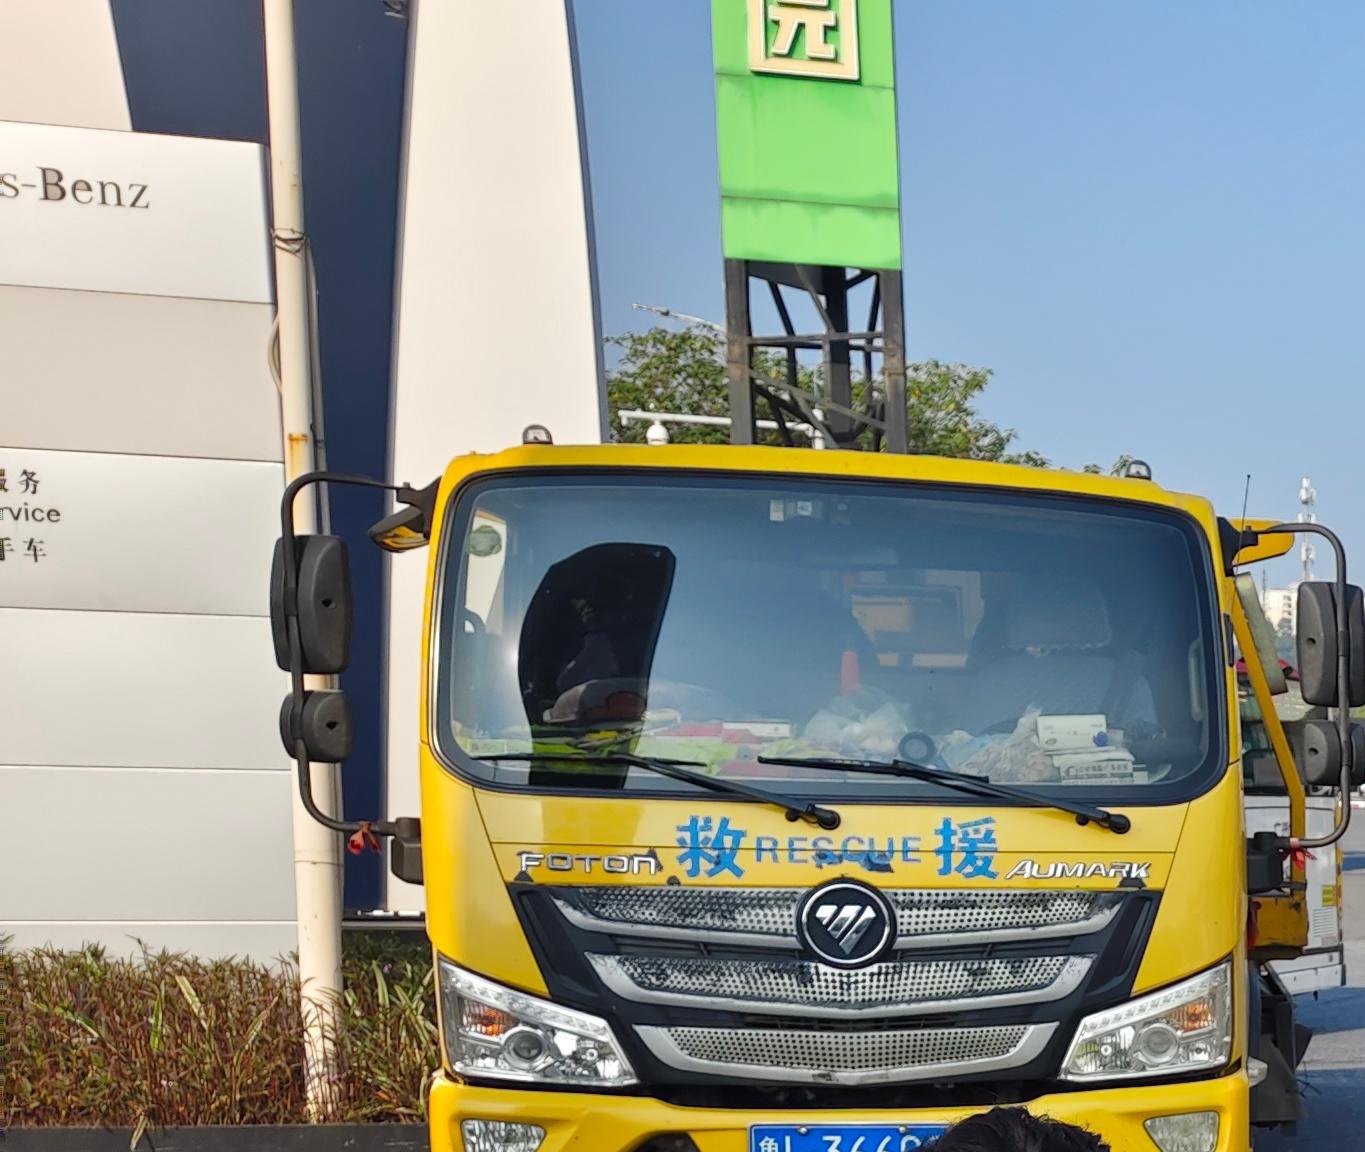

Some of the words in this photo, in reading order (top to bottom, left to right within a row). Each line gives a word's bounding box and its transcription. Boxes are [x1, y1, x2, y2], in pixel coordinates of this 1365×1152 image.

[676, 815, 747, 879] 救
[755, 836, 922, 864] RESCUE
[935, 816, 998, 880] 援
[520, 853, 657, 876] FOTON
[1005, 859, 1152, 880] AUMARK
